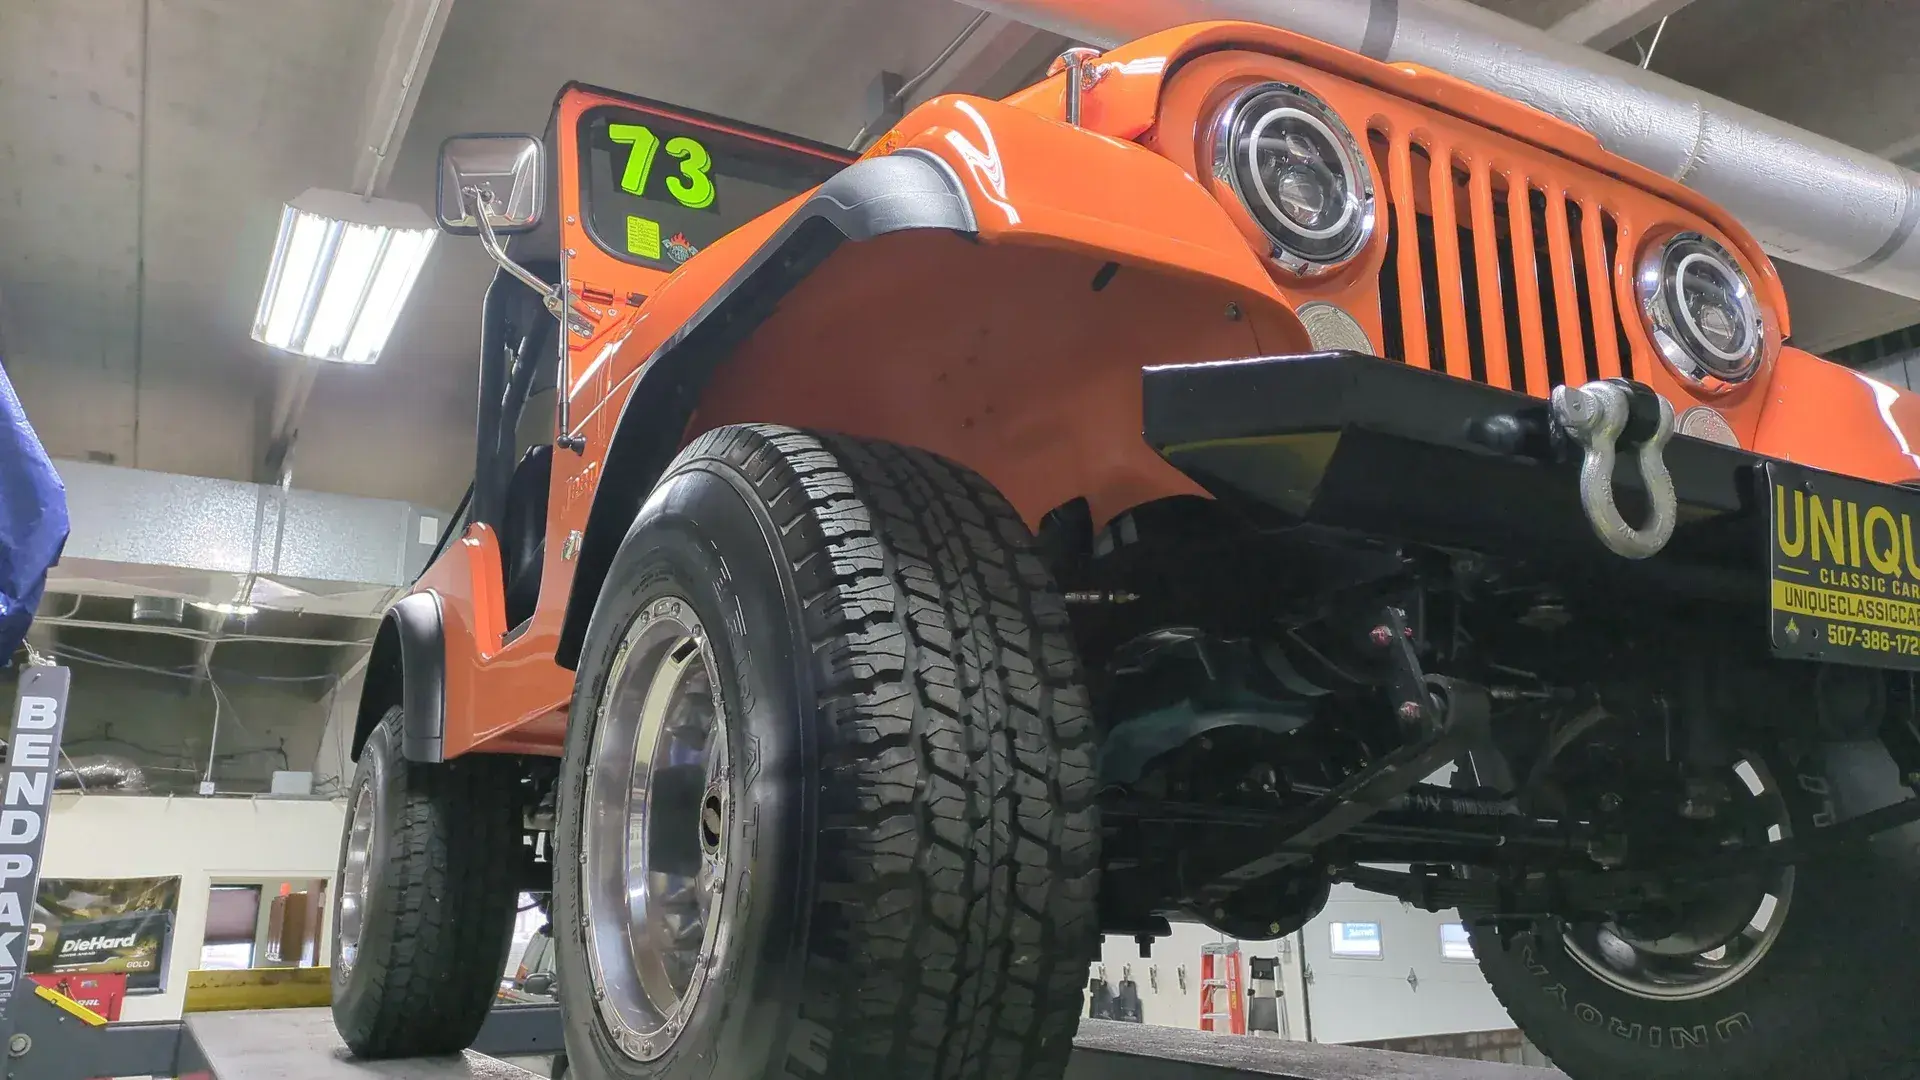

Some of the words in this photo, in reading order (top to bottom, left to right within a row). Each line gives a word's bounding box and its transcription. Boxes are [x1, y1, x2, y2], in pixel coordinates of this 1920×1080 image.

[609, 124, 715, 208] 73
[1820, 568, 1886, 593] CLASSIC
[1827, 623, 1920, 656] 507-386-172
[0, 696, 57, 967] BENDPAK
[61, 933, 137, 953] DieHard
[126, 960, 150, 968] GOLD
[1521, 943, 1753, 1049] UNIROYA
